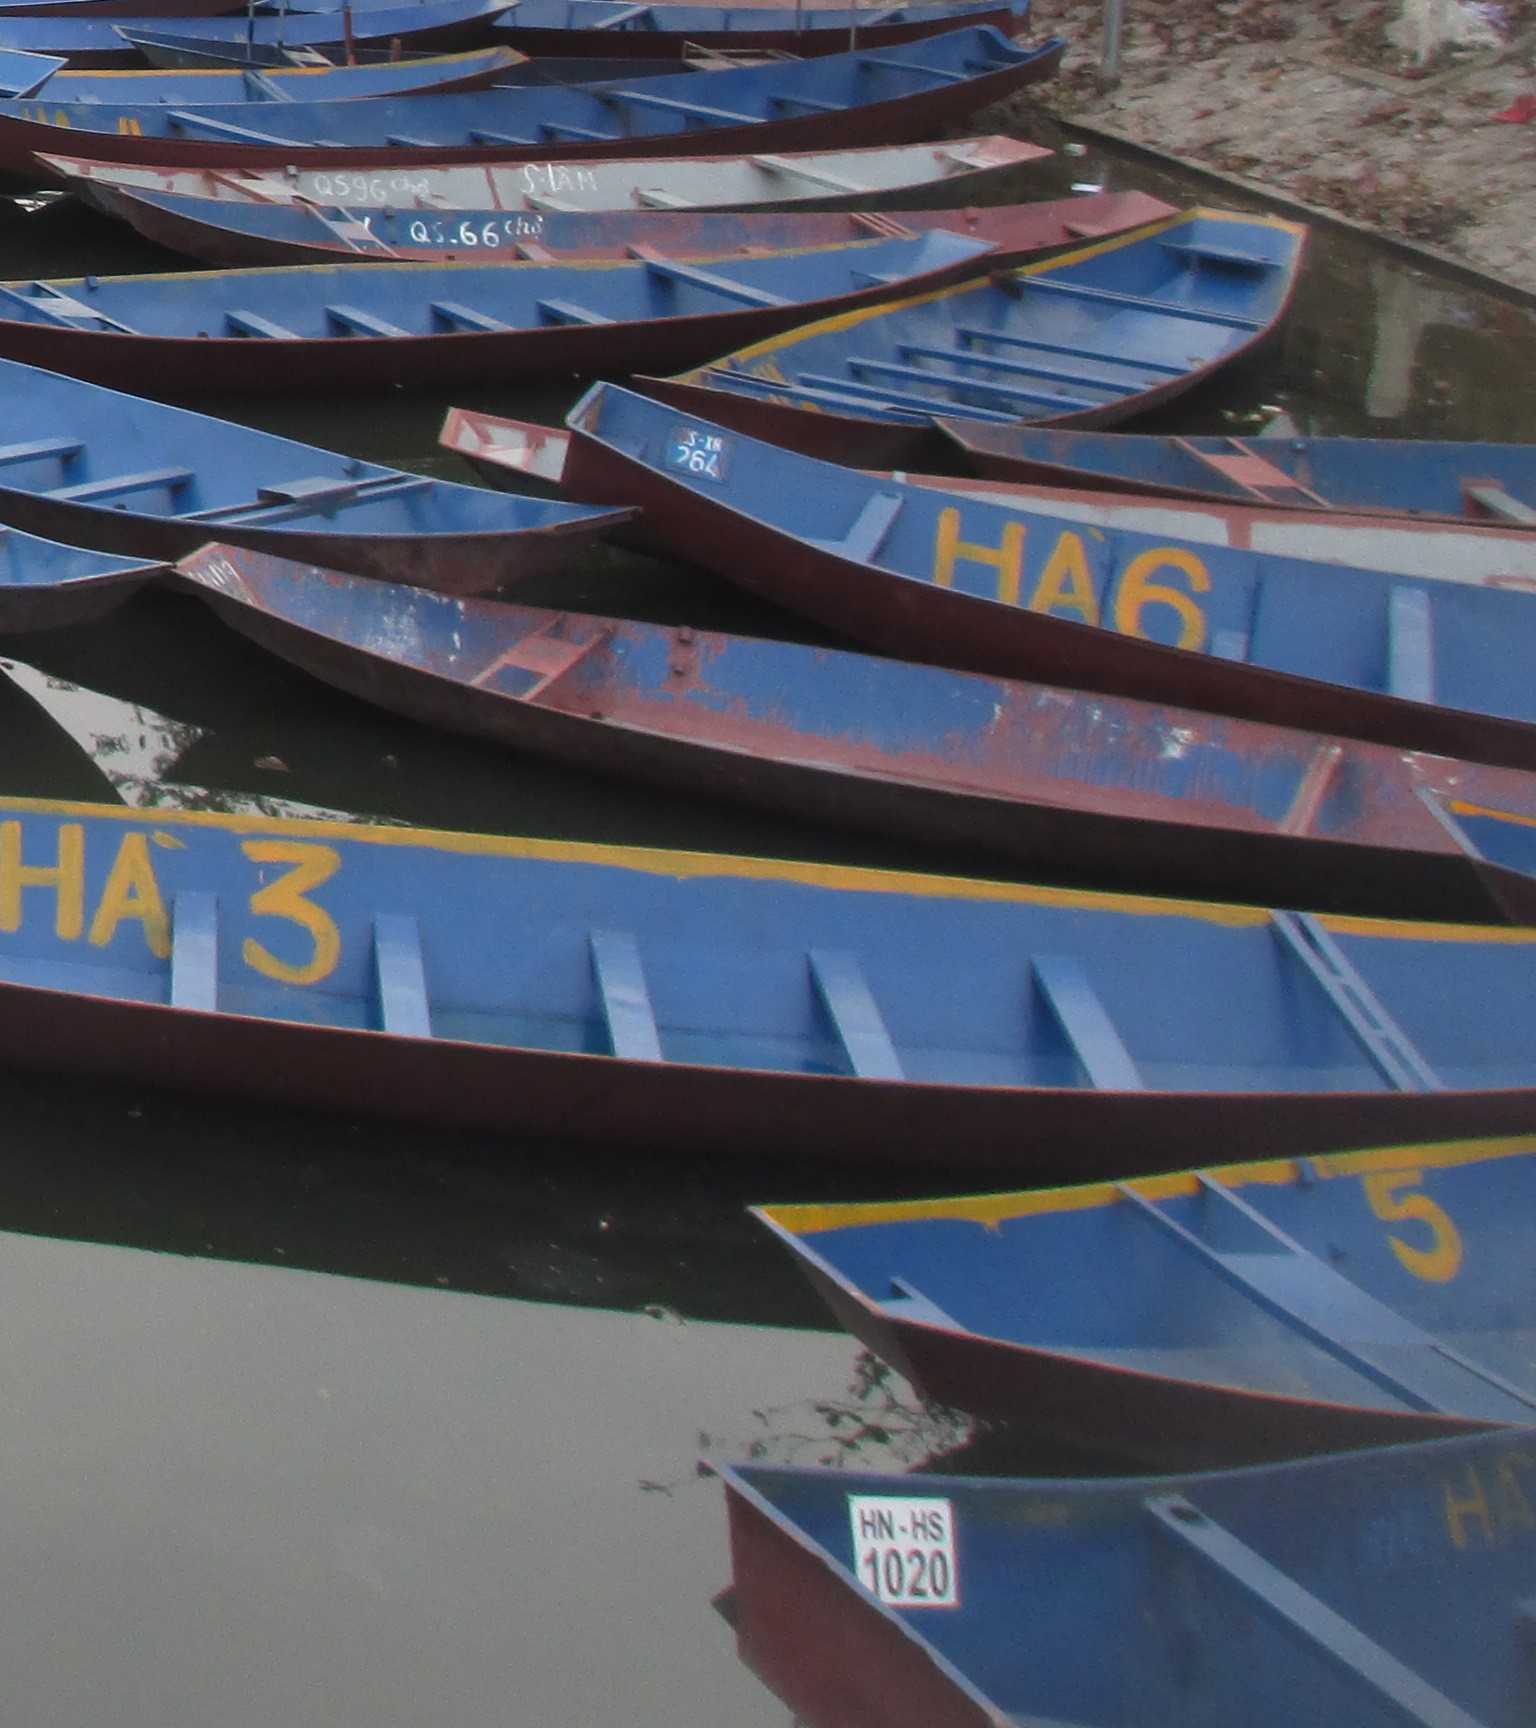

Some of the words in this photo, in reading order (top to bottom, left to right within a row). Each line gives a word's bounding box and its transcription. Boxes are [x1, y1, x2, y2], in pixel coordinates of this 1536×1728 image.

[240, 838, 342, 986] 3
[1361, 1167, 1464, 1283] 5
[863, 1546, 949, 1597] 1020
